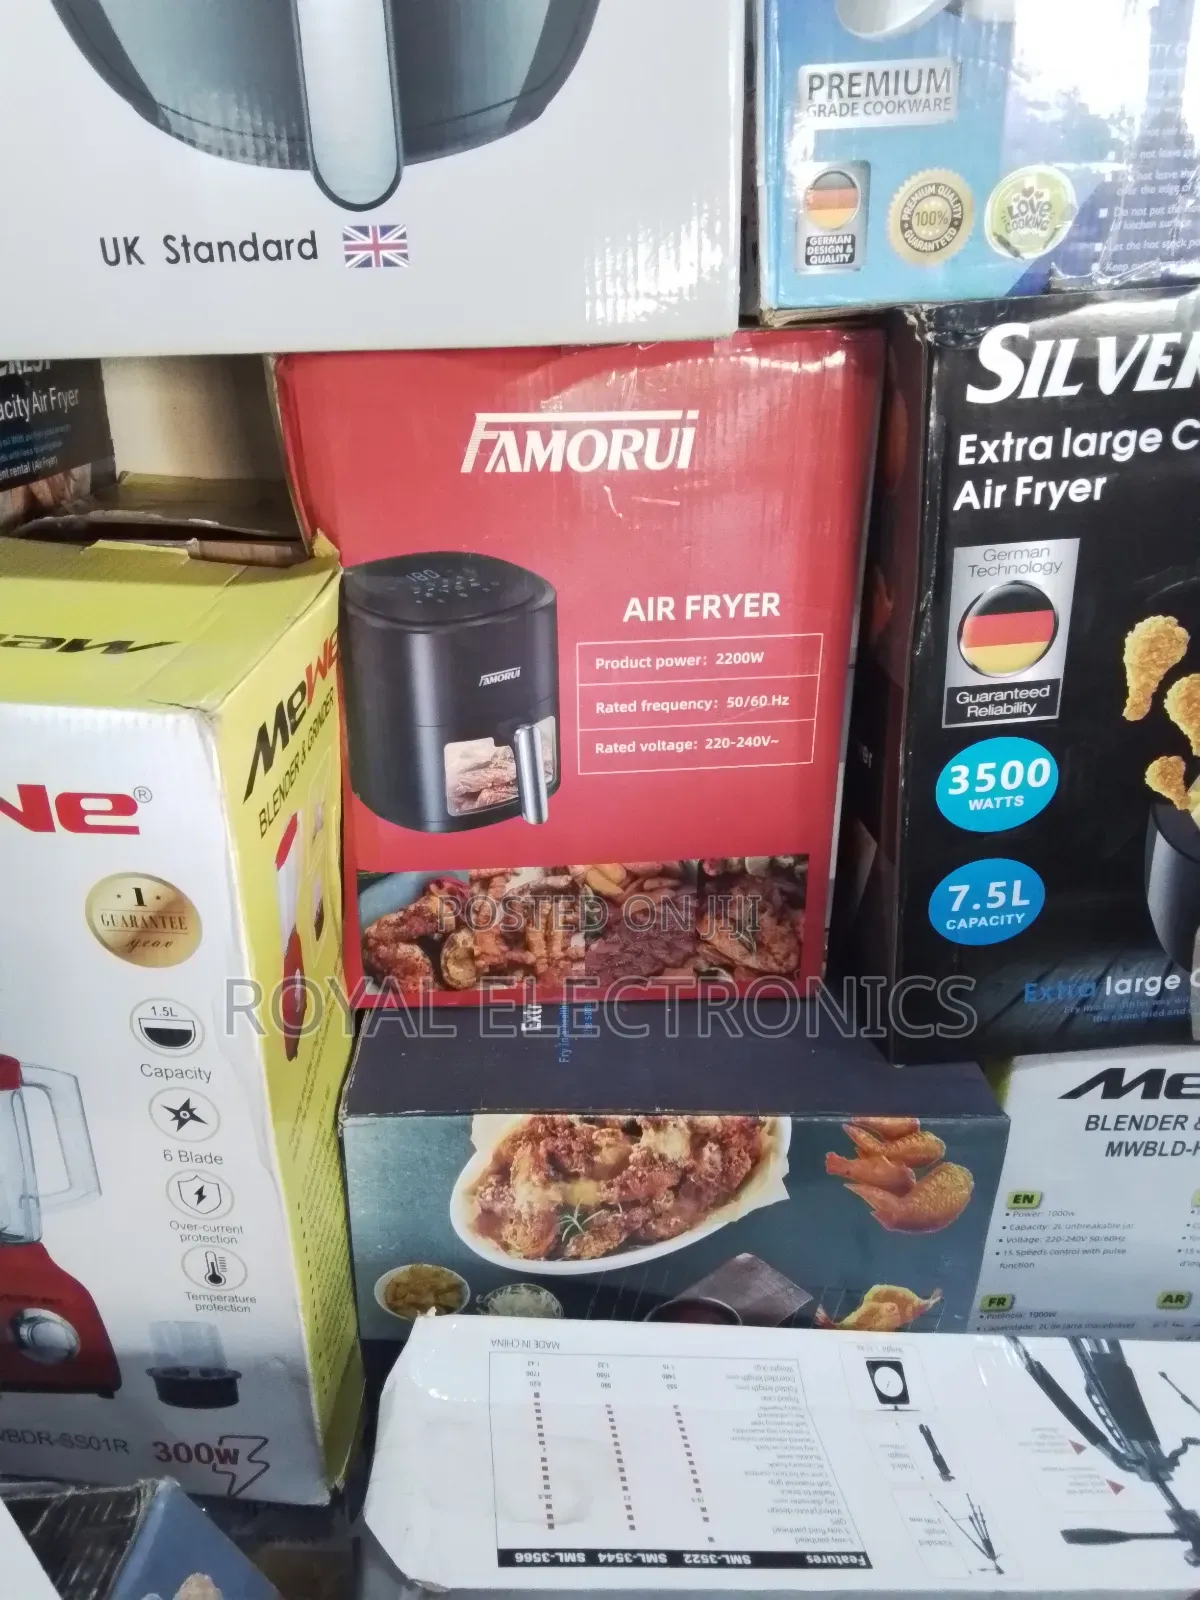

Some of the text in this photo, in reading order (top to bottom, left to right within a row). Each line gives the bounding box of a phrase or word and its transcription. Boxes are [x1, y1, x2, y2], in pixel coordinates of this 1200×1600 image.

[807, 67, 951, 100] PREMIUM
[806, 96, 953, 118] GRADE COOKWARE
[899, 183, 963, 221] PREMIUM QUALITY
[915, 210, 949, 226] 100%
[99, 230, 319, 267] UK Standard
[809, 235, 852, 246] GERMAN
[903, 229, 959, 253] GUARANTEED
[806, 244, 854, 256] DESIGN &
[809, 253, 852, 265] QUALITY
[32, 389, 47, 415] Air
[49, 386, 79, 413] Fryer
[957, 432, 1053, 466] Extra
[1061, 427, 1163, 462] large
[952, 475, 1107, 511] Air Fryer
[982, 547, 1051, 562] German
[407, 569, 440, 582] 180
[967, 560, 1064, 578] Technology
[622, 592, 780, 622] AIR FRYER
[595, 652, 765, 671] Product power: 2200W
[478, 666, 521, 687] FAMORUI
[956, 685, 1050, 704] Guaranteed
[595, 694, 790, 714] Rated frequency: 50/60 Hz
[966, 702, 1038, 718] Reliability
[595, 735, 780, 754] Rated voltage: 220-240V~
[947, 757, 1052, 796] 3500
[259, 749, 301, 840] BLENDER
[968, 795, 1025, 811] WATTS
[132, 887, 147, 907] 1
[947, 879, 1031, 912] 7.5L
[100, 913, 188, 932] GUARANTEE
[945, 913, 1026, 931] CAPACITY
[1024, 980, 1097, 1004] Extra
[1105, 974, 1182, 997] large
[150, 1005, 178, 1018] 1.5L
[140, 1063, 213, 1084] Capacity
[1084, 1114, 1189, 1131] BLENDER
[163, 1150, 225, 1166] 6 Blade
[1012, 1193, 1035, 1205] EN
[168, 1220, 245, 1236] Over-current
[1065, 1222, 1120, 1231] unbreakable
[180, 1232, 239, 1246] protection
[1045, 1235, 1088, 1244] 220-240V
[1015, 1248, 1047, 1258] Speeds
[1049, 1247, 1080, 1256] control
[1081, 1247, 1101, 1256] with
[1101, 1247, 1127, 1257] pulse
[999, 1261, 1036, 1270] function
[184, 1290, 258, 1305] Temperature
[987, 1297, 1008, 1307] FR
[1161, 1294, 1186, 1304] AR
[194, 1301, 252, 1315] protection
[490, 1338, 561, 1350] MADE IN CHINA
[152, 1440, 240, 1466] 300w
[514, 1551, 867, 1566] Features SML-3522 SML-3544 SML-3566
